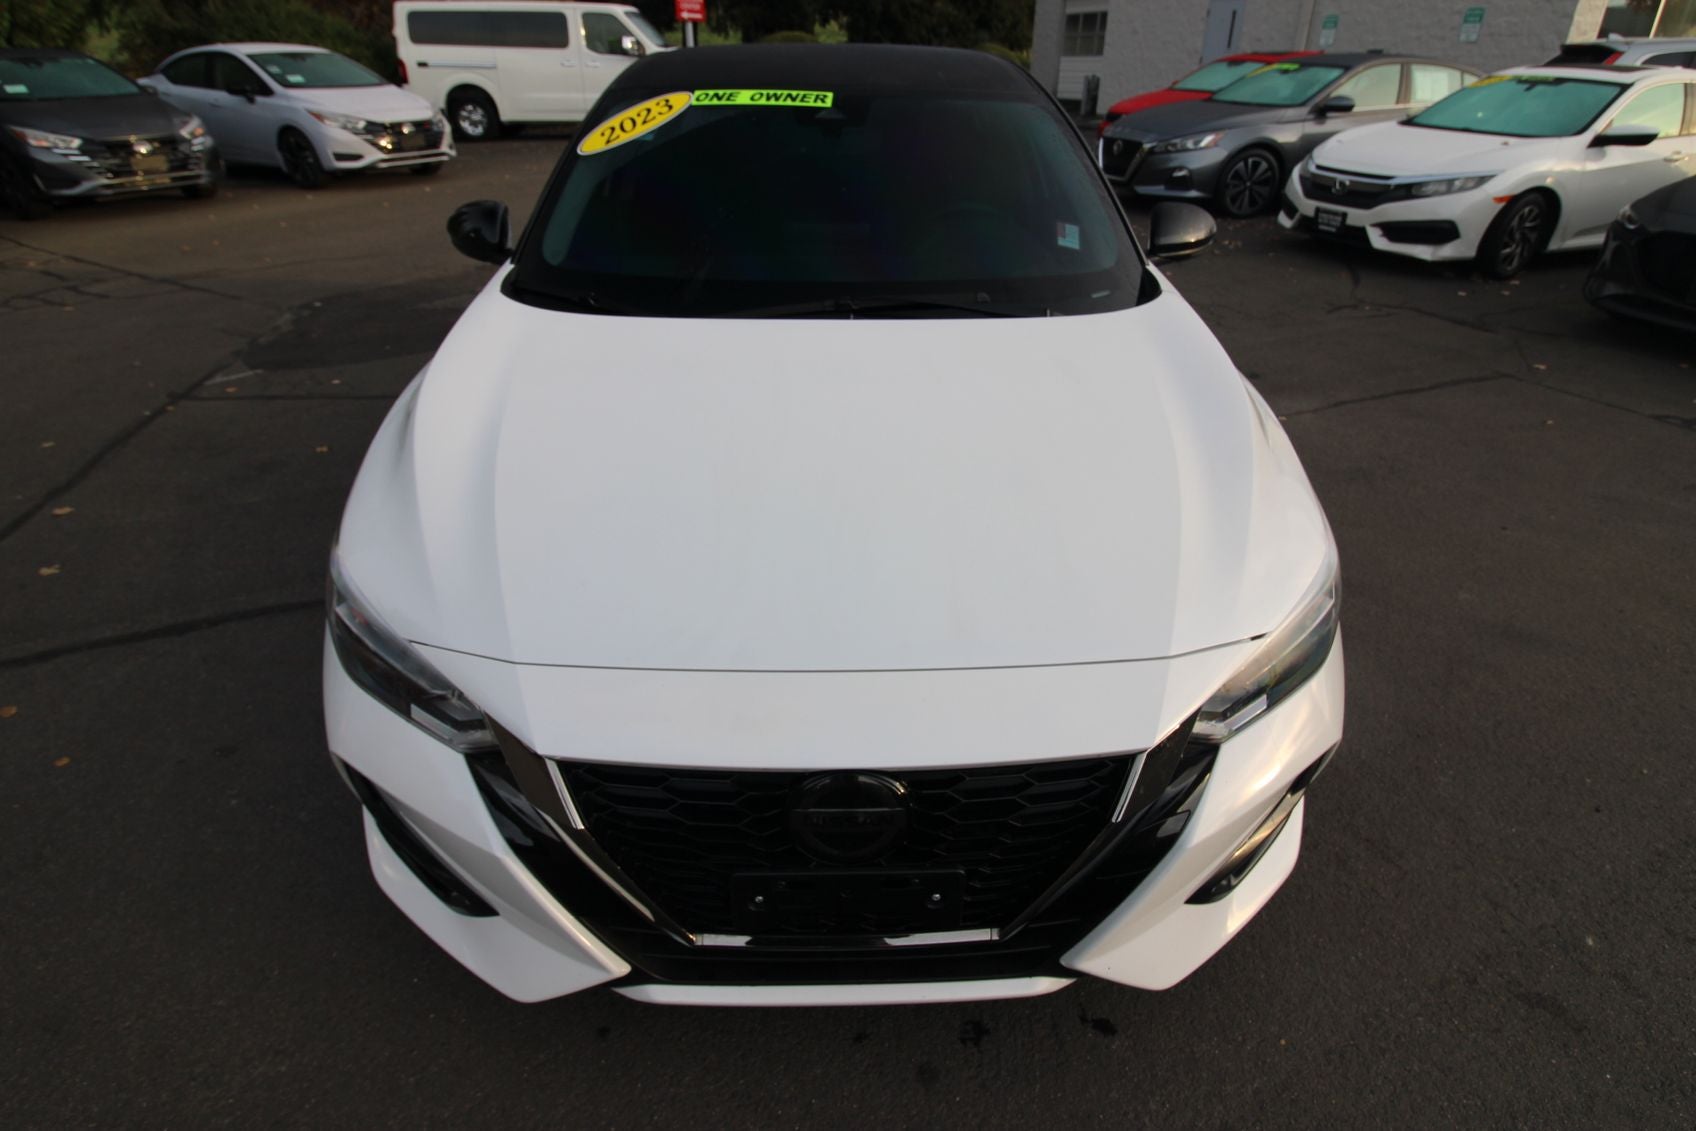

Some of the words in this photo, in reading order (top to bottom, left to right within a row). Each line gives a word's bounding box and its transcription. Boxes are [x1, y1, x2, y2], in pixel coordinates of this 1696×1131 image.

[696, 91, 740, 102] ONE
[750, 92, 828, 104] OWNER
[601, 98, 674, 145] 2023
